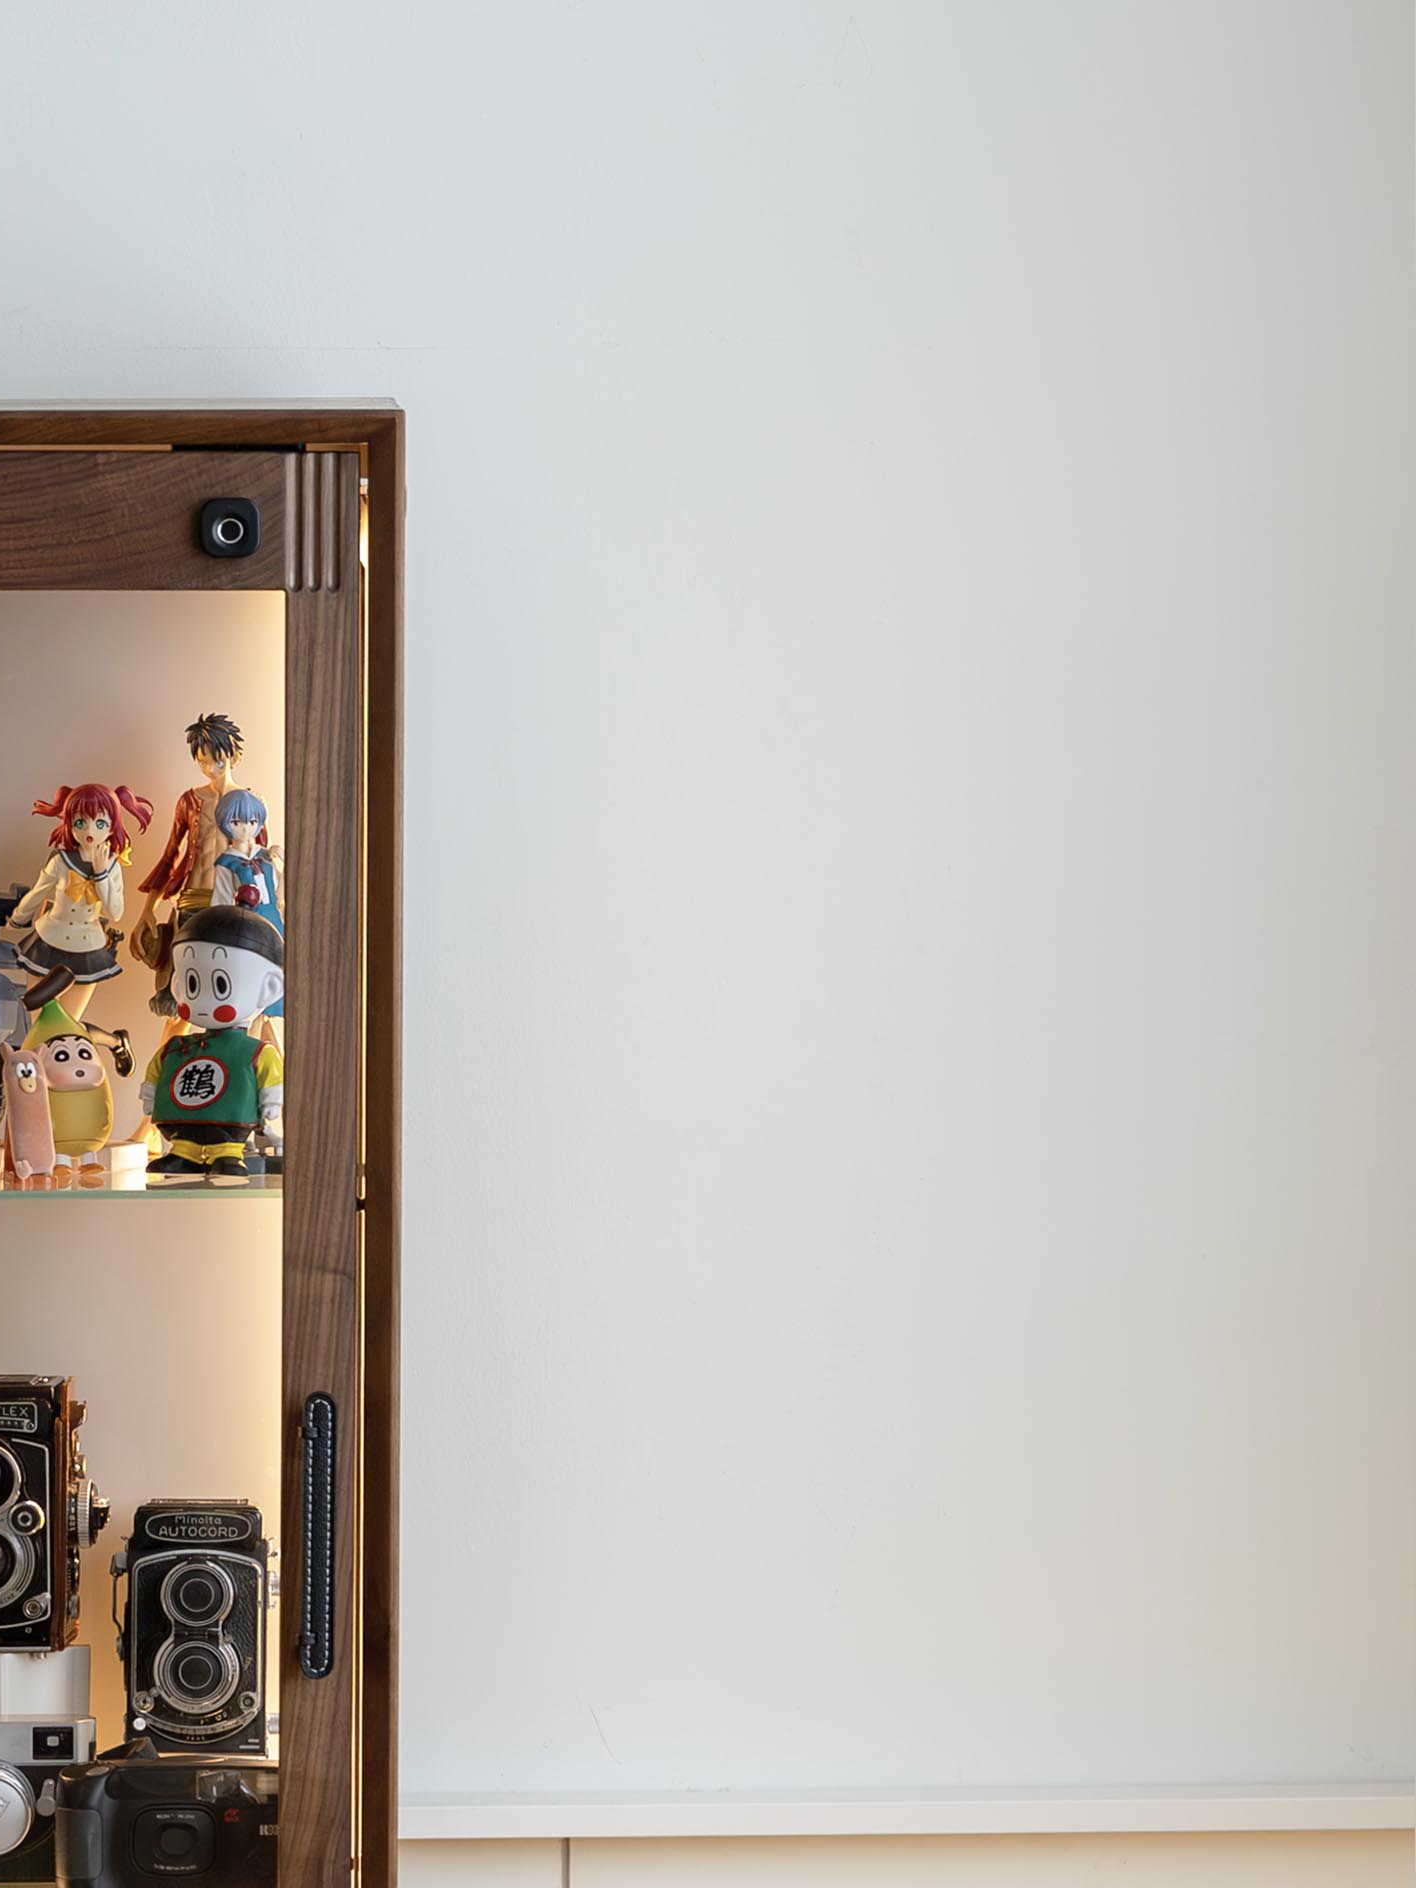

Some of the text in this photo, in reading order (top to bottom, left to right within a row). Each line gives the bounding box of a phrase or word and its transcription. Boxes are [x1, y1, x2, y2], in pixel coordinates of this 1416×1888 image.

[178, 1064, 216, 1099] 鶴
[174, 1515, 223, 1525] Minolta
[158, 1526, 239, 1537] AUTOCORD
